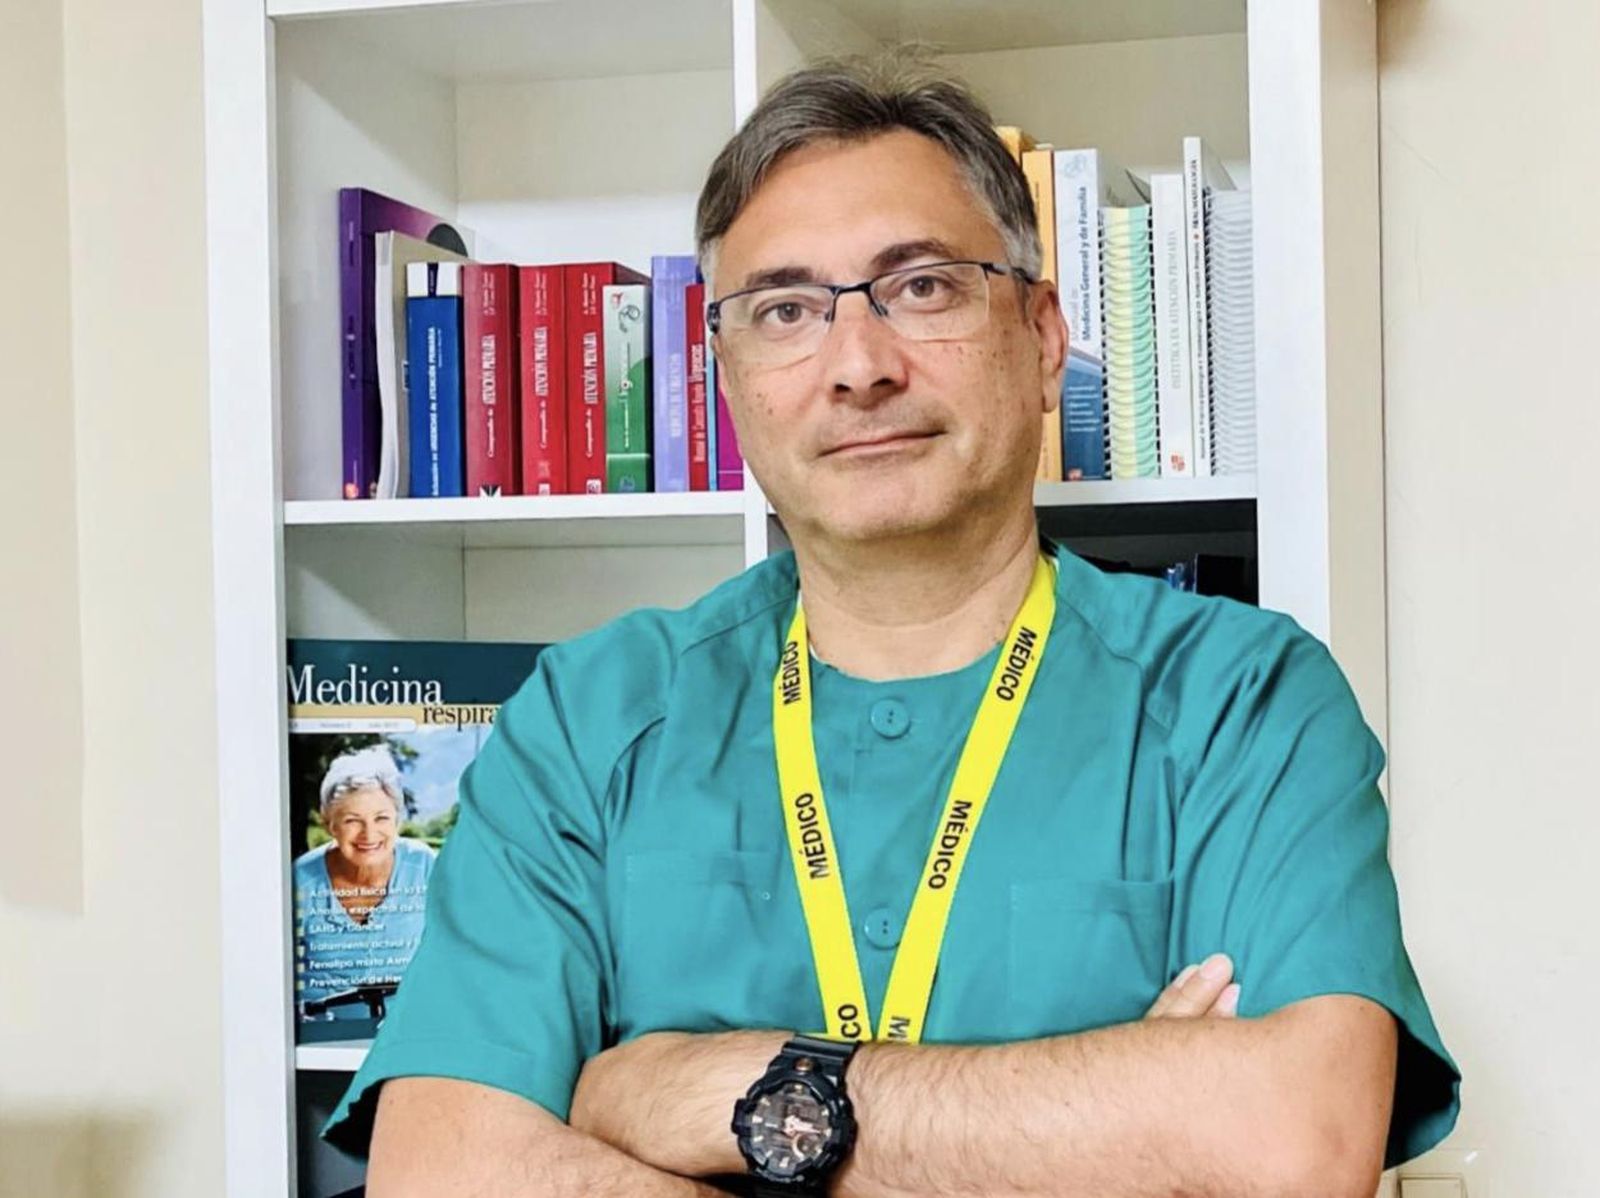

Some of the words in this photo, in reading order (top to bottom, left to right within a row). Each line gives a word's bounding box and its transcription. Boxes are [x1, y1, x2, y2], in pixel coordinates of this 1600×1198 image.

[1077, 187, 1089, 224] Familia
[1079, 226, 1090, 239] de
[1079, 249, 1091, 291] General
[1080, 293, 1092, 341] Medicina
[427, 327, 436, 364] PRIMARIA
[428, 365, 437, 400] ATENCIÓN
[288, 664, 444, 706] Medicina
[778, 640, 802, 706] MÉDICO
[996, 626, 1038, 702] MÉDICO
[794, 792, 830, 880] MÉDICO
[928, 800, 973, 890] MÉDICO
